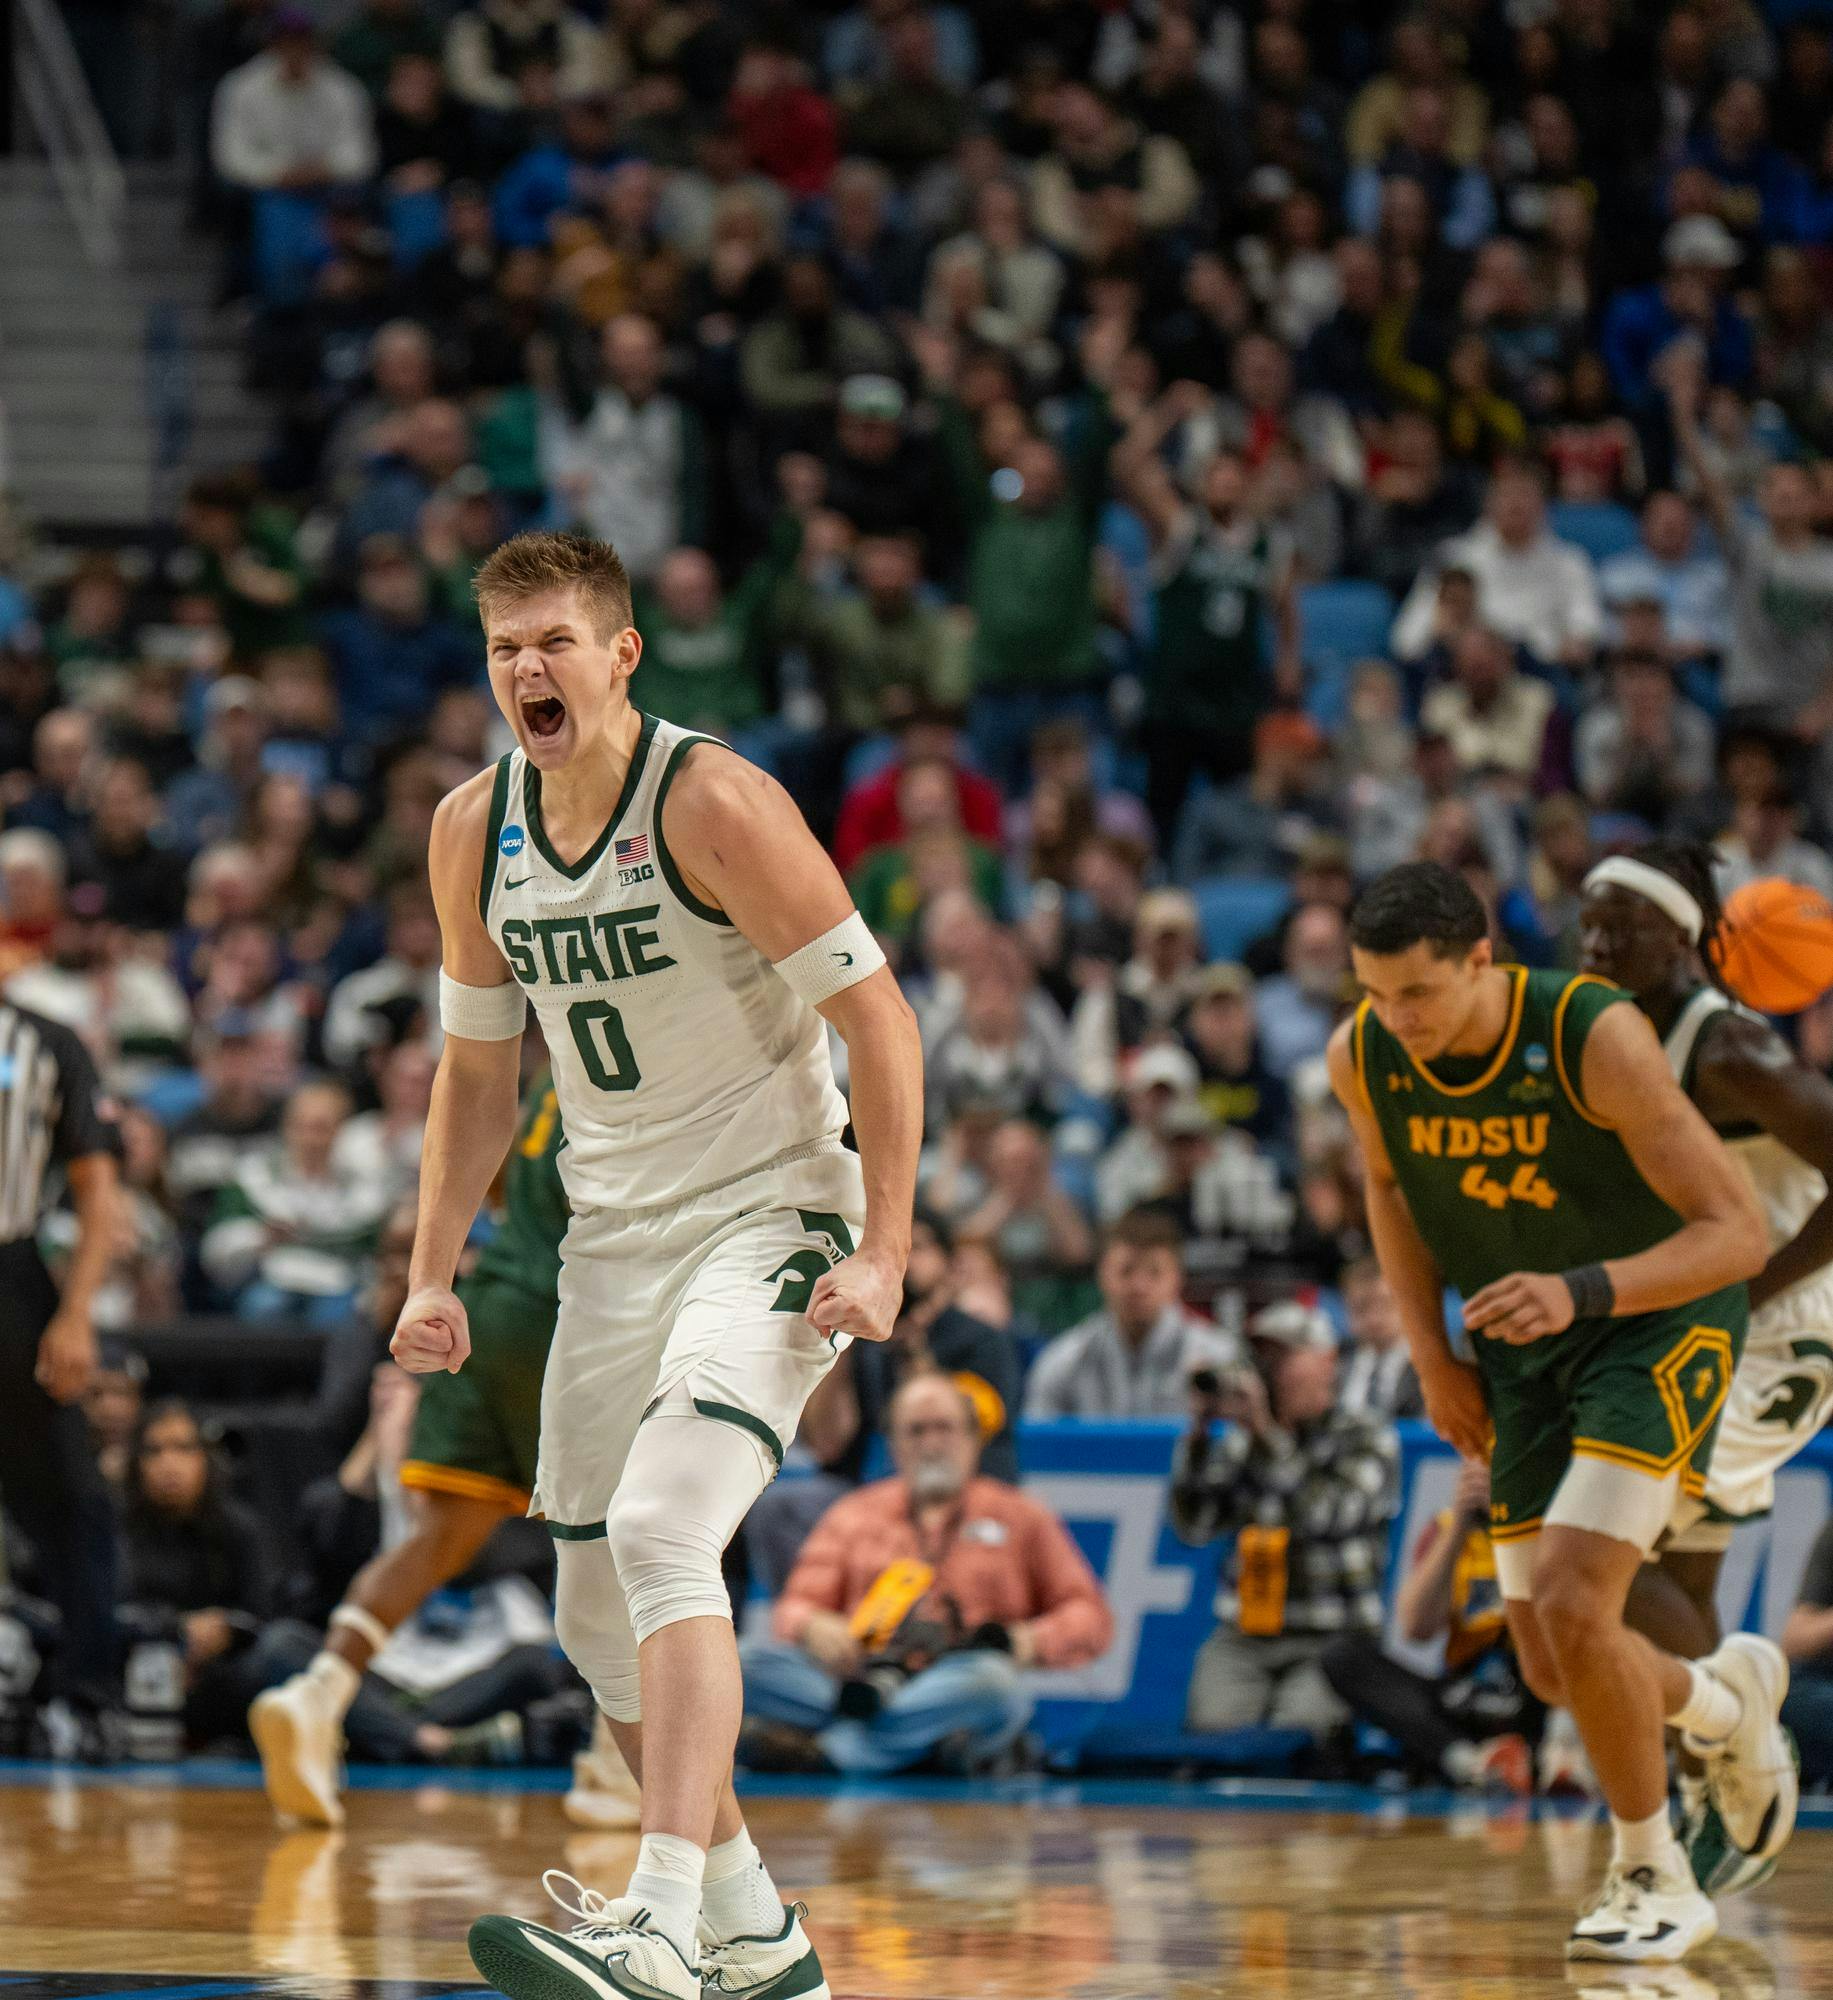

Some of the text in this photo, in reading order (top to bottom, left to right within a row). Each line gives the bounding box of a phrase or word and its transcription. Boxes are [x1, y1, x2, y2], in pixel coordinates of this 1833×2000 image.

[501, 838, 522, 849] NCAA
[501, 904, 678, 985] STATE
[567, 999, 642, 1092] 0
[1408, 1113, 1549, 1159] NDSU
[1460, 1163, 1558, 1209] 44
